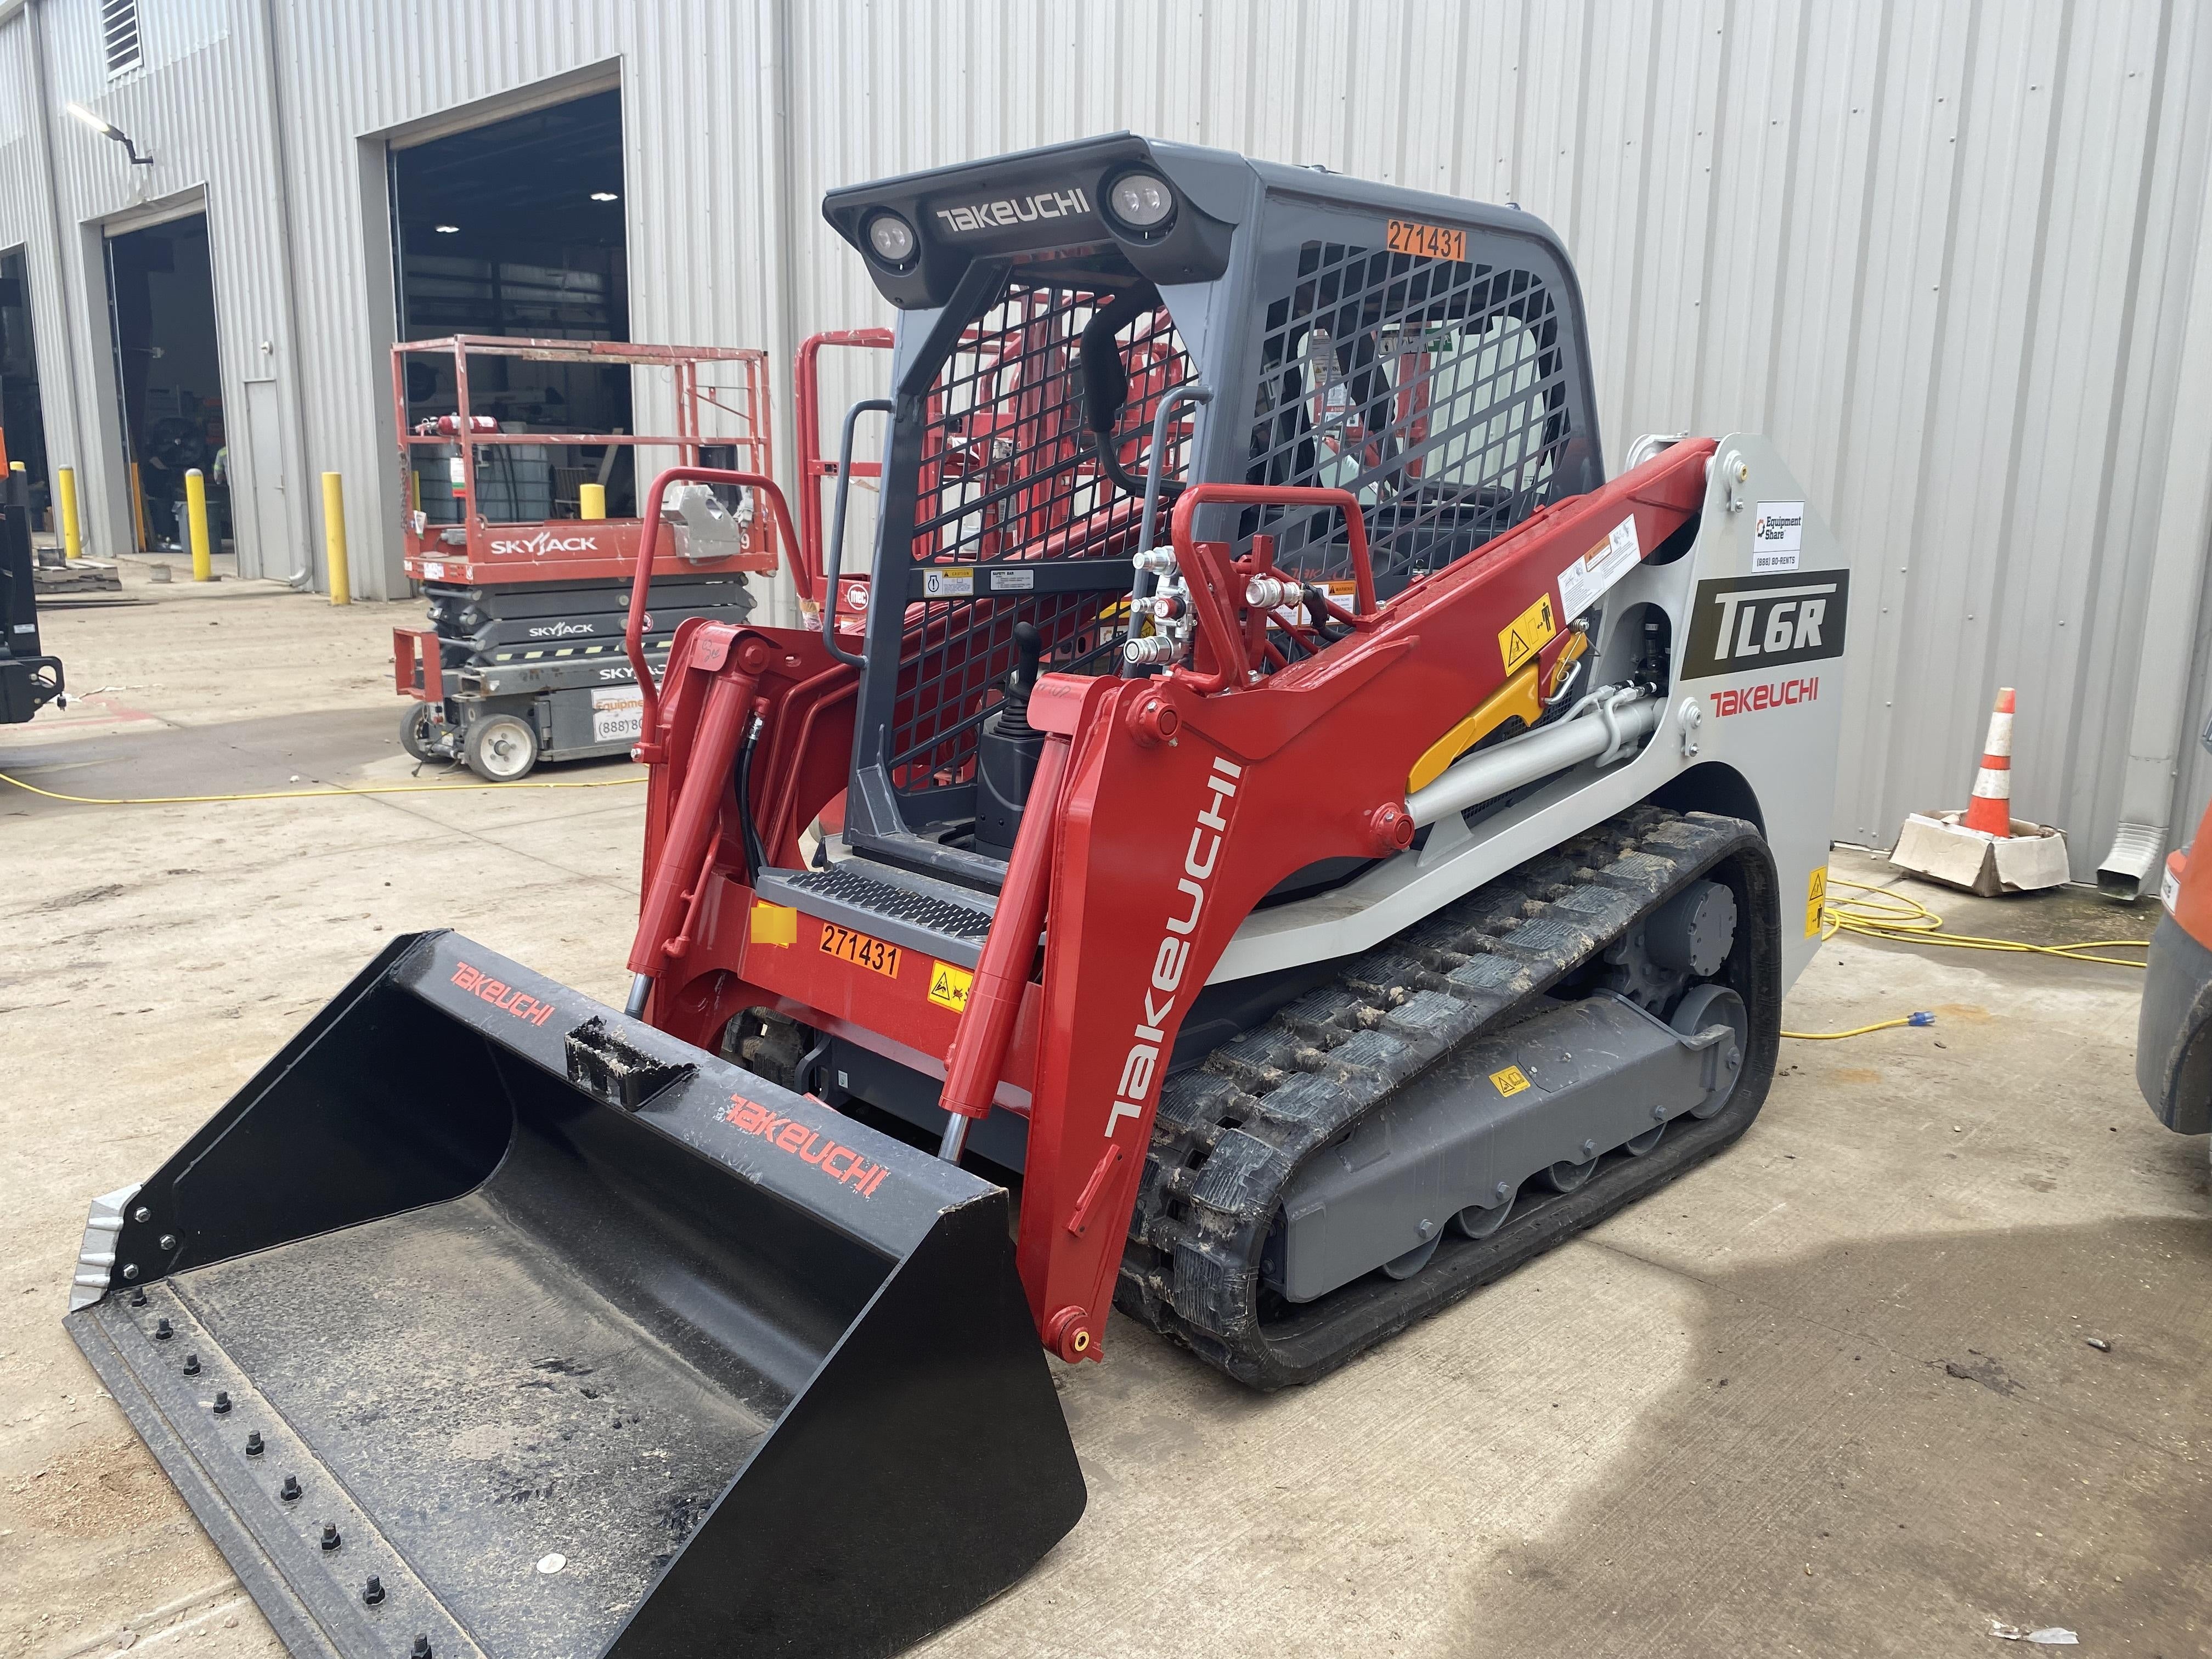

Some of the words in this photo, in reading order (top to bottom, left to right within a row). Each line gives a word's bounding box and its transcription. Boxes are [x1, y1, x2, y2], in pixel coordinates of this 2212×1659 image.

[936, 187, 1091, 233] TAKEUCHI
[1387, 221, 1465, 258] 271431
[1765, 529, 1785, 540] Share
[1766, 516, 1802, 529] Equipment
[490, 531, 597, 556] SKYJACK
[1757, 557, 1770, 567] (888)
[1771, 556, 1796, 566] 80-RENTS
[529, 621, 594, 637] SKYJACK
[1714, 583, 1837, 661] TL6R
[1710, 677, 1819, 718] TAKEUCHI
[599, 719, 629, 738] (888)
[821, 925, 898, 976] 271431
[1104, 756, 1242, 1138] TAKEUCHI
[450, 961, 556, 1027] TAKEUCHI
[725, 1092, 890, 1199] TAKEUCHI
